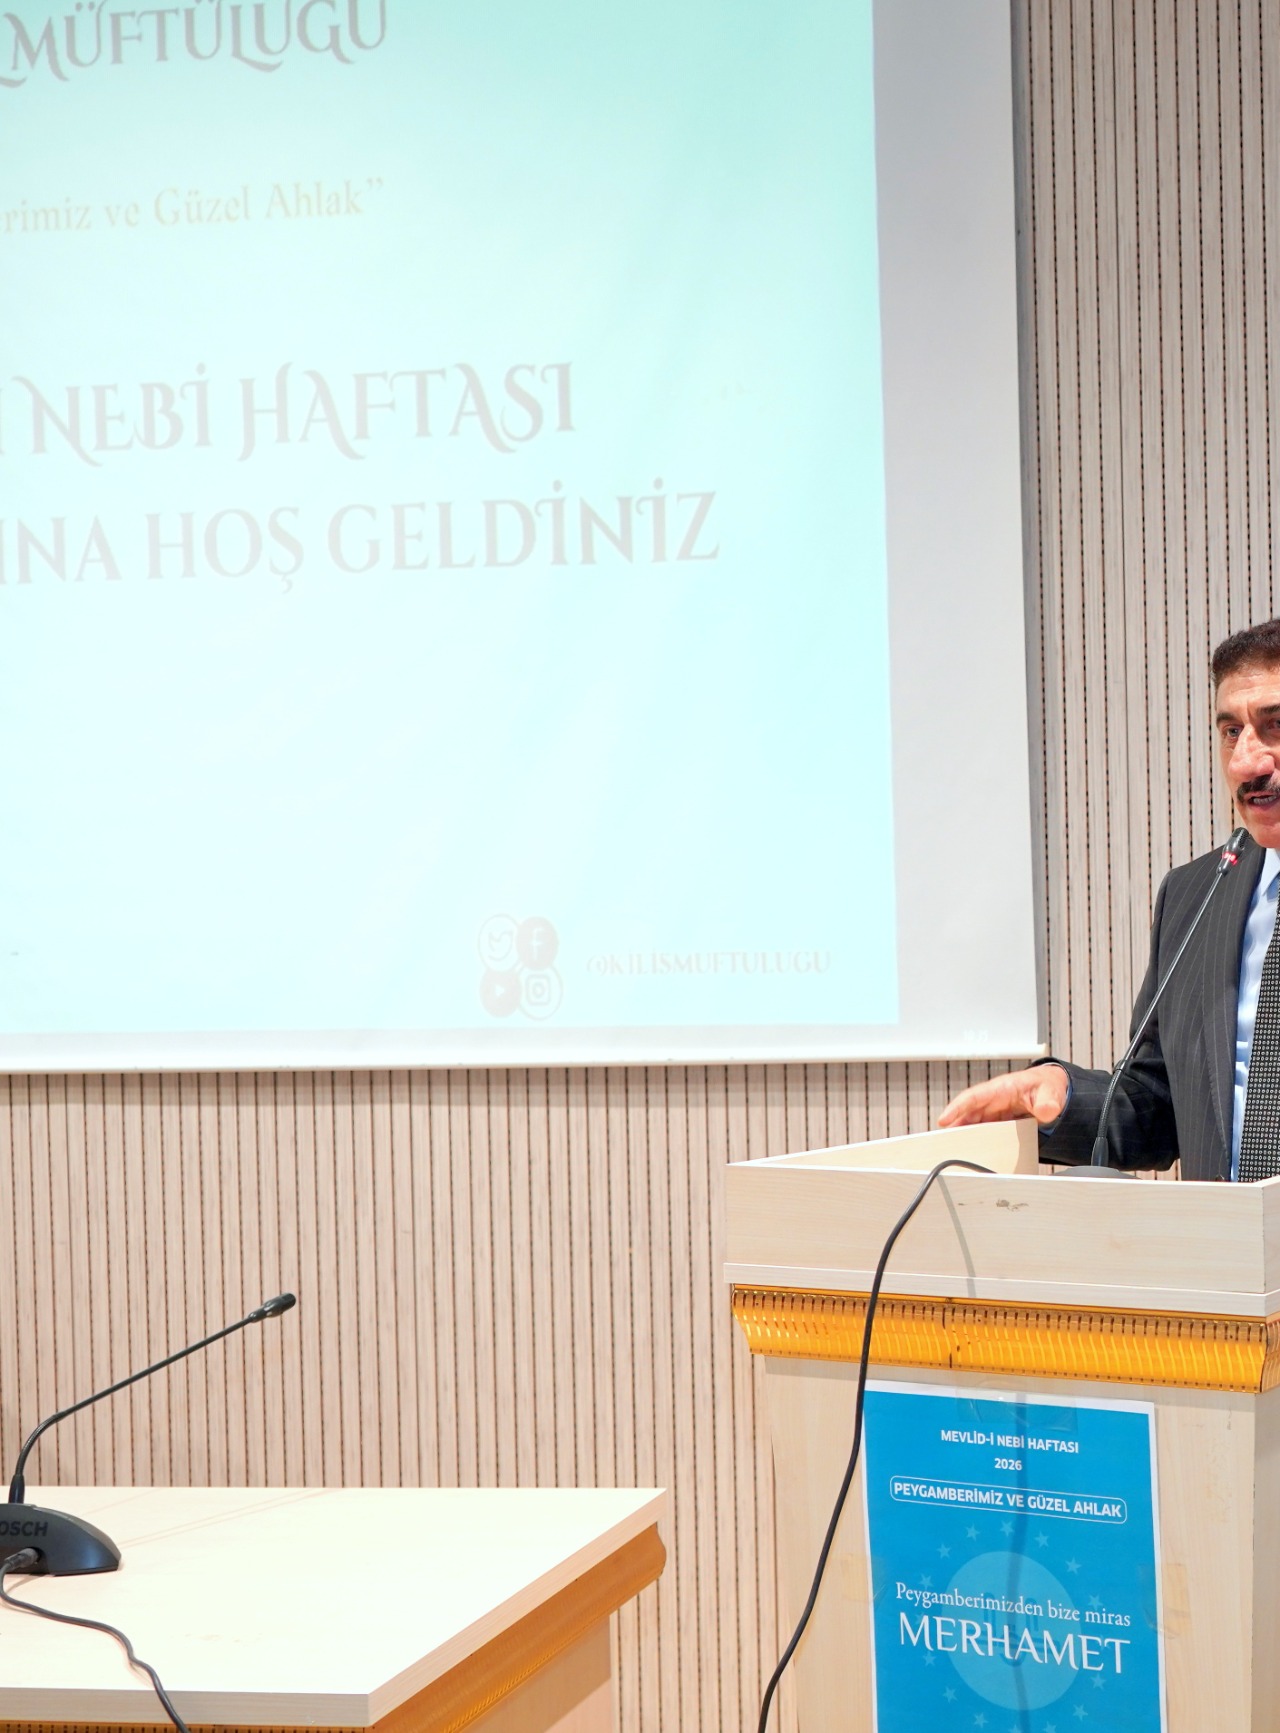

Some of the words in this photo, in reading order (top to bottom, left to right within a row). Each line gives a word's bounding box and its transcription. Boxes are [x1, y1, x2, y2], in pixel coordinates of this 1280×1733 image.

[0, 197, 92, 234] rimiz
[104, 202, 140, 228] ve
[154, 184, 251, 226] Güzel
[12, 362, 212, 467] NEBİ
[237, 361, 575, 462] HAFTASI
[145, 506, 304, 594] HOŞ
[327, 478, 720, 575] GELDİNİZ
[941, 1429, 994, 1446] MEVLİD-İ
[997, 1434, 1025, 1449] NEBİ
[1028, 1438, 1079, 1453] HAFTASI
[994, 1457, 1023, 1471] 2026
[894, 1482, 1004, 1505] PEYGAMBERİMİZ
[1005, 1494, 1025, 1509] VE
[1026, 1495, 1071, 1513] GÜZEL
[1072, 1500, 1123, 1519] AHLAK
[895, 1581, 1044, 1616] Peygamberimizden
[1046, 1599, 1082, 1622] bize
[1083, 1607, 1132, 1627] miras
[899, 1612, 1131, 1674] MERHAMET
